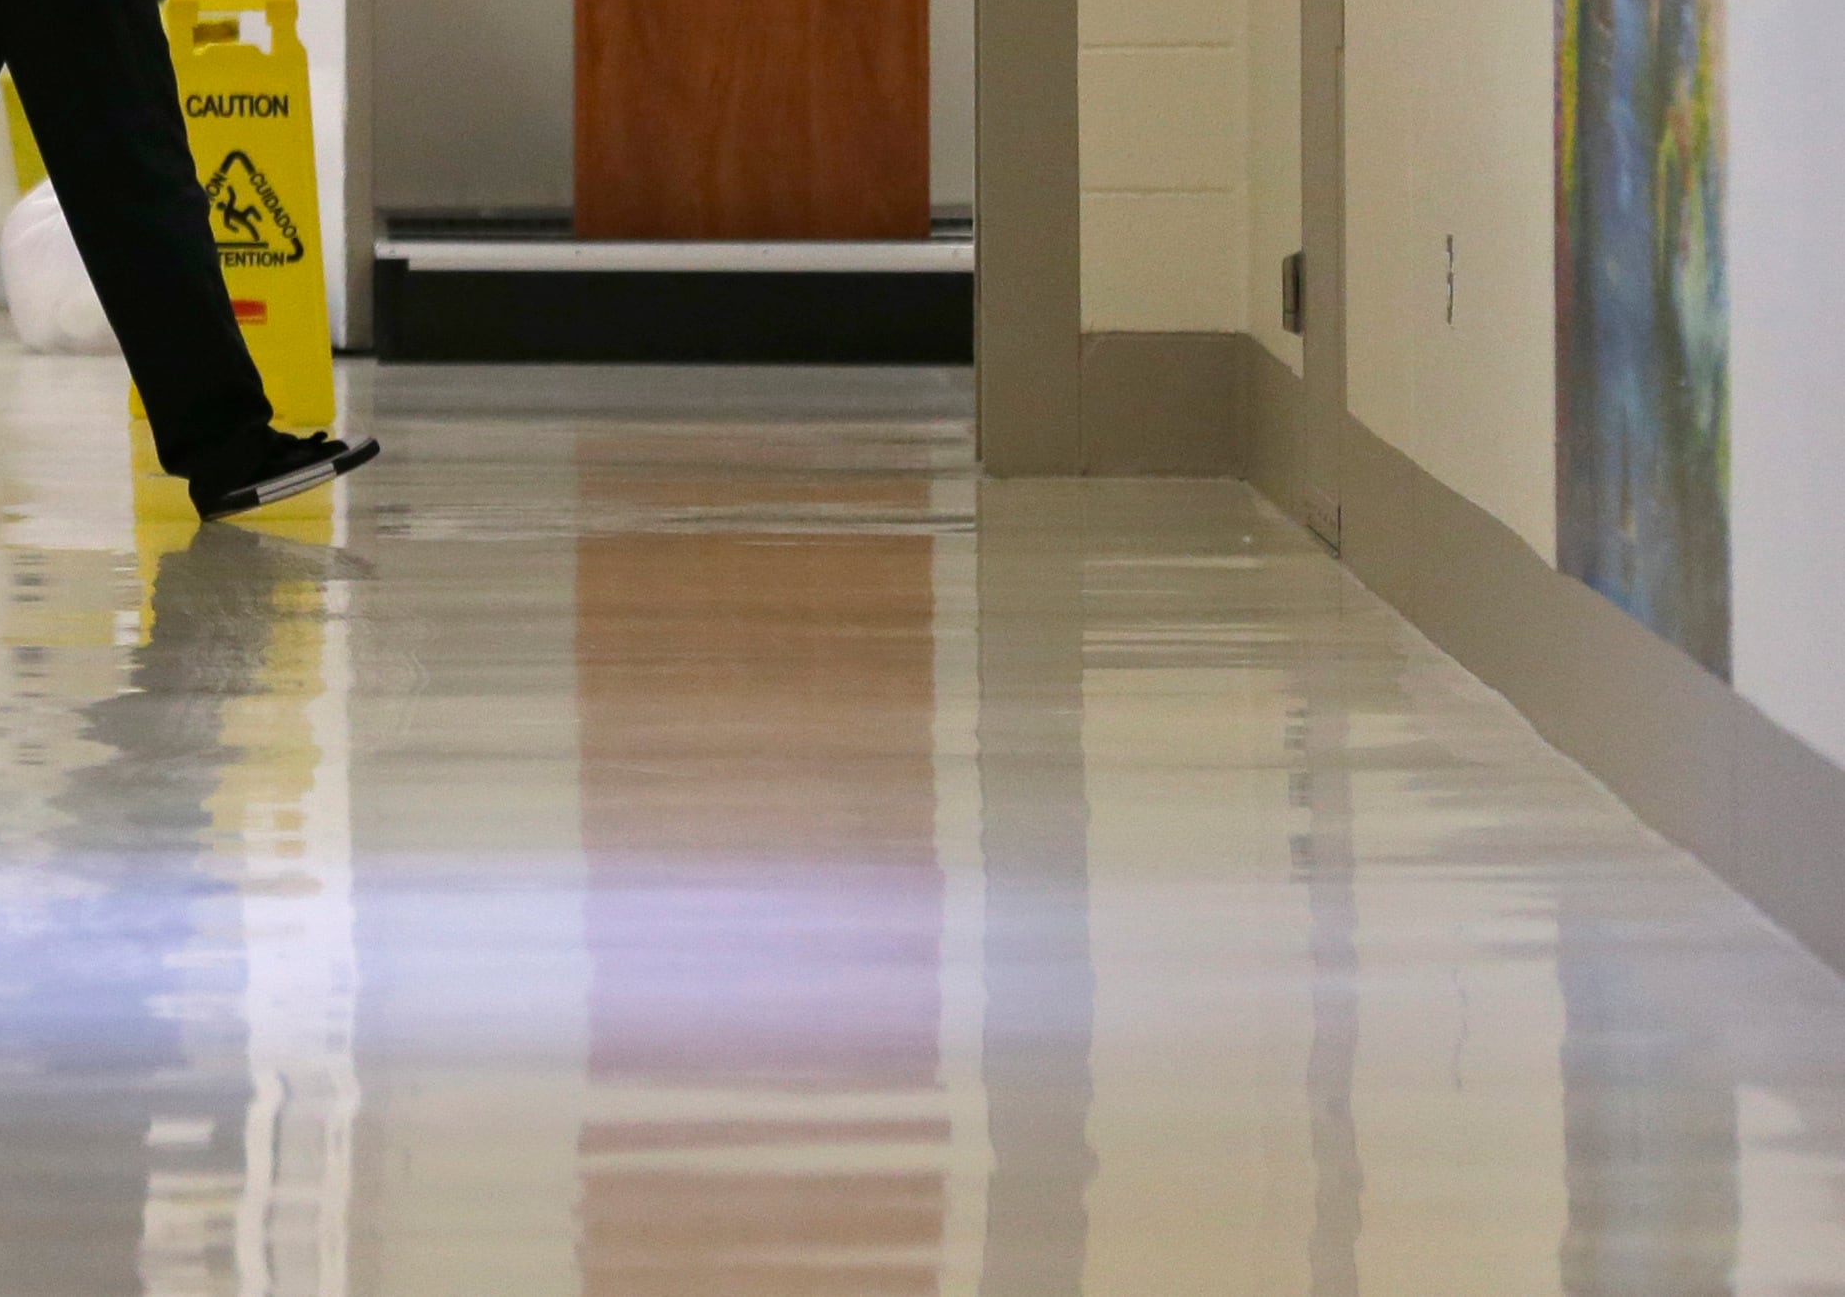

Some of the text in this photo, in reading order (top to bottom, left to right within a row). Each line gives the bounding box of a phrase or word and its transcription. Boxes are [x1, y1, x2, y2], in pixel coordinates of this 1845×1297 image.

[186, 94, 289, 118] CAUTION
[249, 172, 297, 238] CUIDADO
[217, 252, 285, 267] TENTION
